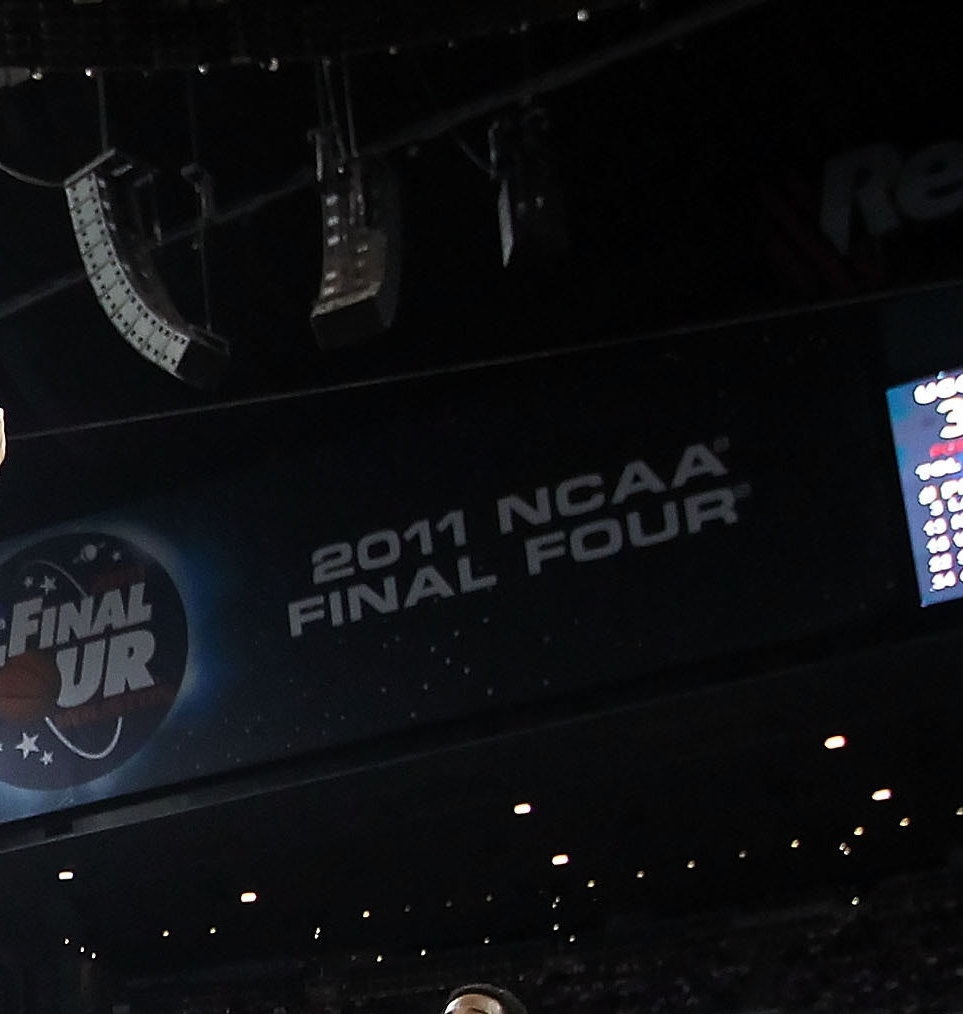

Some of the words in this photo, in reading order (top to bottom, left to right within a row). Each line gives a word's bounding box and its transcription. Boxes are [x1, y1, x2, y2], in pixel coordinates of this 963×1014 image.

[287, 555, 498, 637] FINAL
[524, 487, 739, 576] FOUR
[311, 509, 467, 584] 2011
[497, 443, 729, 535] NCAA
[8, 581, 153, 658] FINAL
